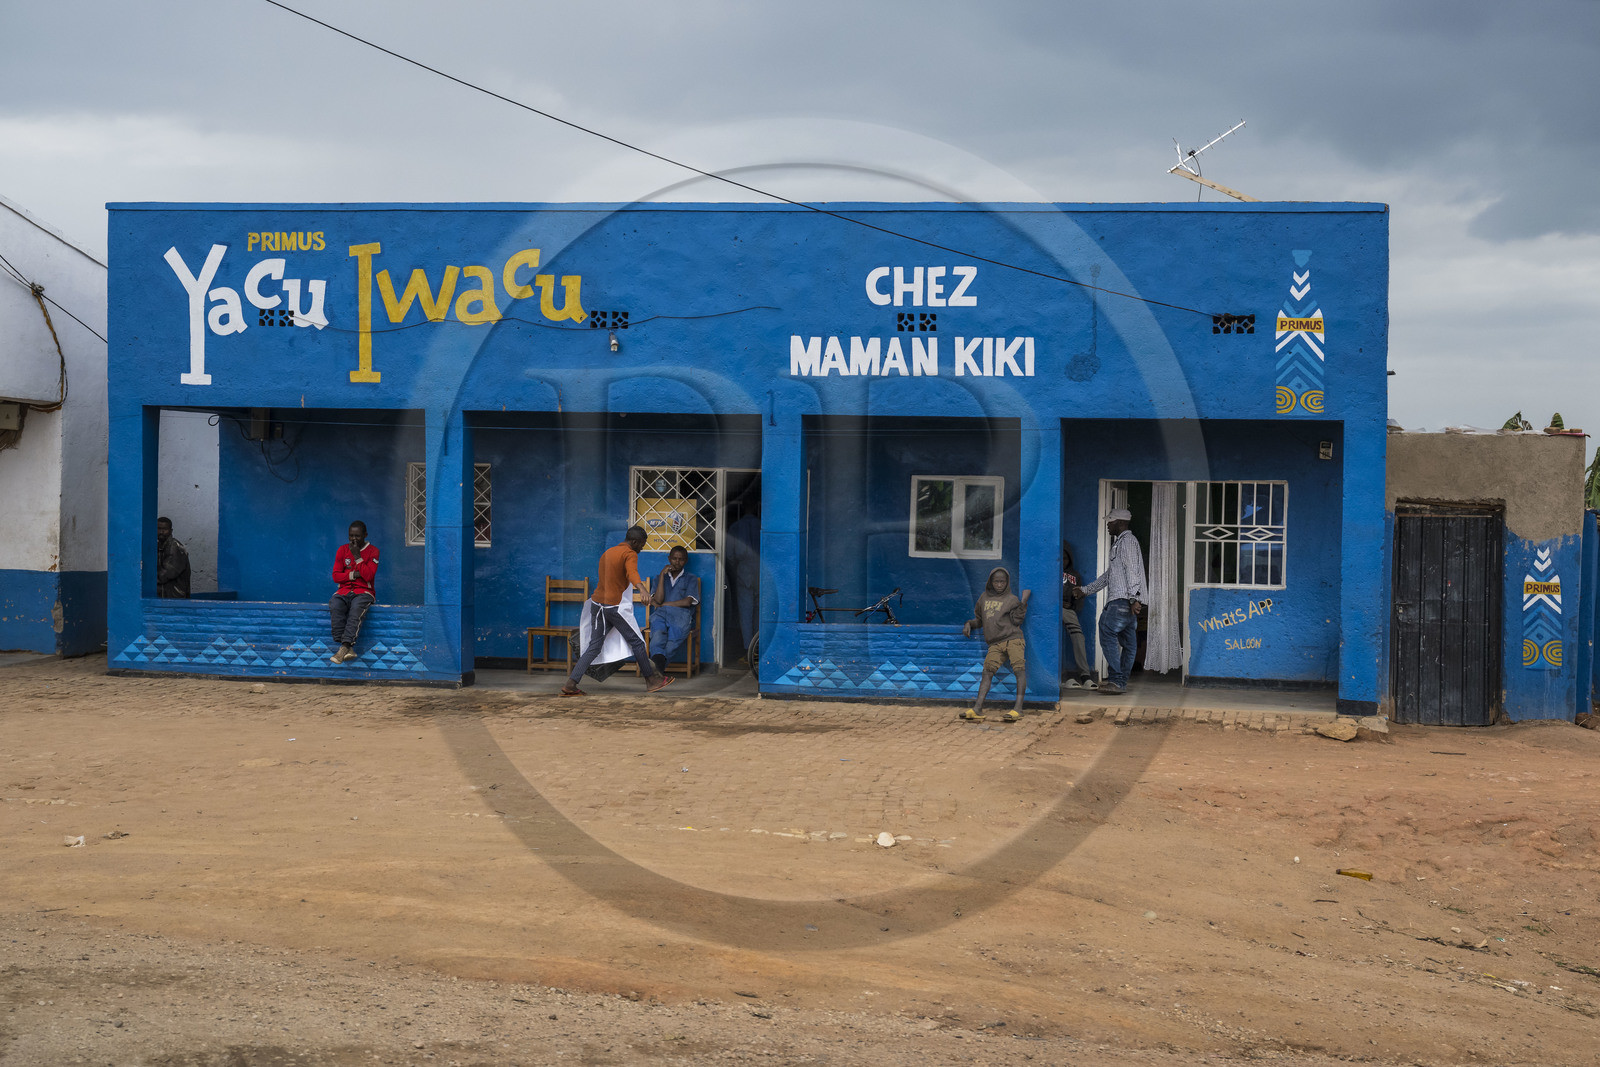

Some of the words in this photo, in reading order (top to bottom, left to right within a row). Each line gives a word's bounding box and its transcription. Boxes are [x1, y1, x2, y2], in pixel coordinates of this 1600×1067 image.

[247, 231, 326, 252] PRIMUS
[865, 266, 978, 307] CHEZ
[163, 244, 328, 386] Yacu
[348, 242, 589, 384] Iwacu
[1279, 319, 1322, 331] PRIMUS
[790, 335, 939, 377] MAMAN
[954, 336, 1035, 377] KIKI
[1525, 583, 1560, 594] PRIMUS
